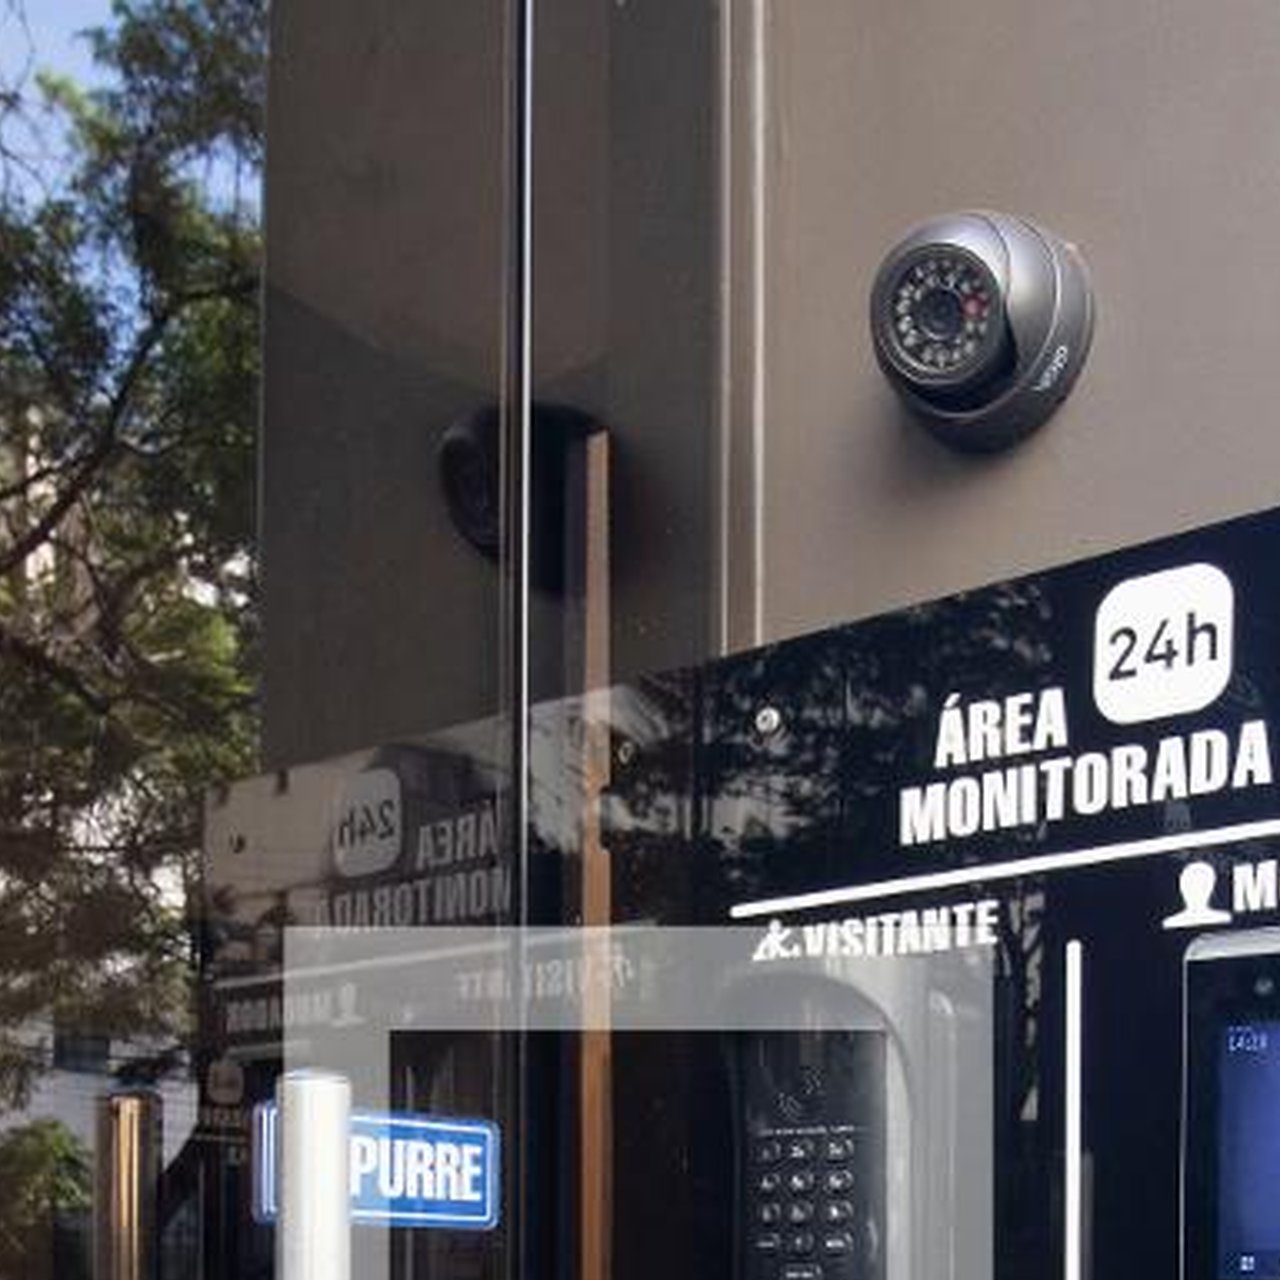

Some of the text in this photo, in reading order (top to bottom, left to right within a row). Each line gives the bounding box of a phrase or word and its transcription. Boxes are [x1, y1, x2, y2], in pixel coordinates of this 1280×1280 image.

[1107, 613, 1220, 681] 24h
[936, 687, 1068, 768] ÁREA
[900, 719, 1273, 846] MONITORADA
[803, 901, 1000, 959] VISITANTE
[351, 1134, 483, 1201] PURRE
